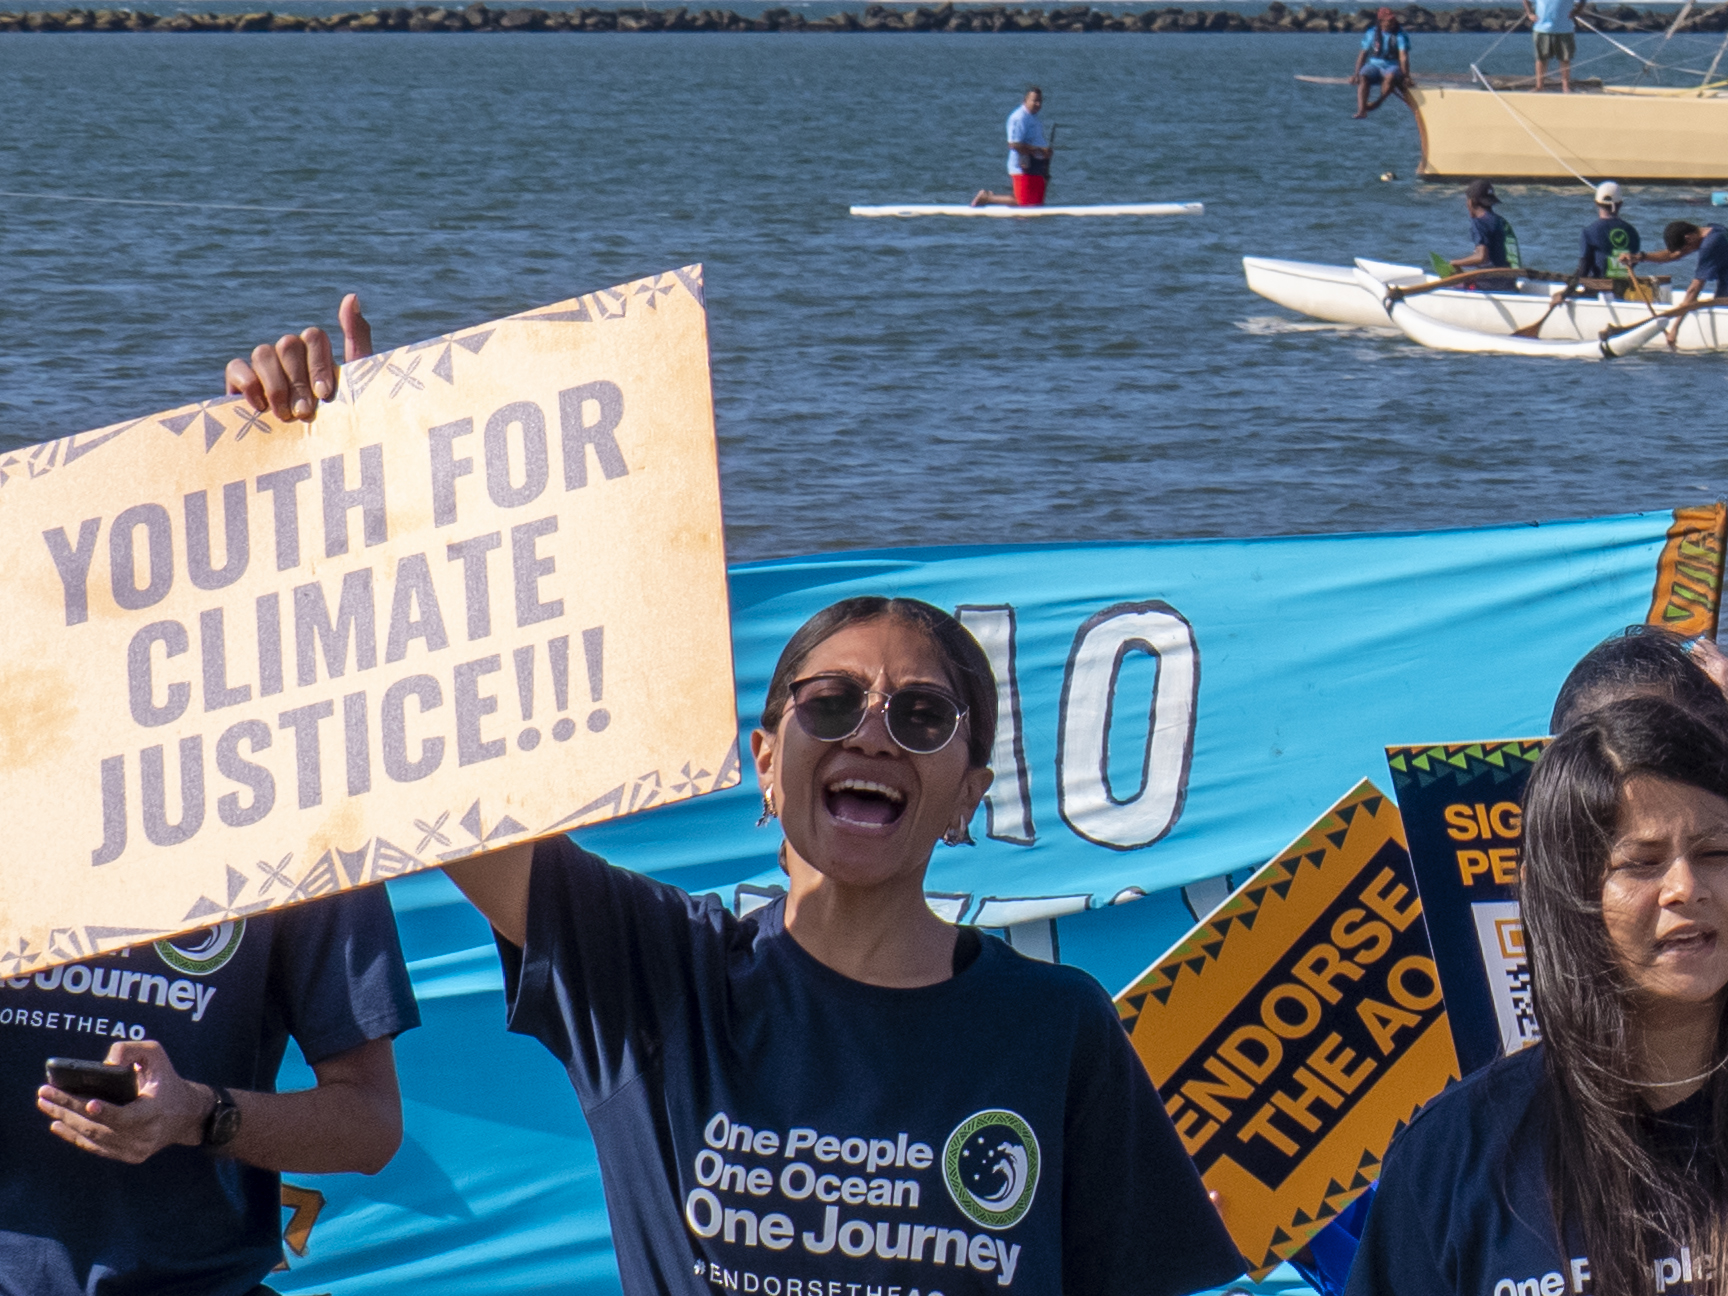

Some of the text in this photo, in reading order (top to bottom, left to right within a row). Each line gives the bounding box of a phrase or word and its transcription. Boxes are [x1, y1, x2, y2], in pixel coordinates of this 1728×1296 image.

[42, 379, 629, 627] YOUTH FOR
[126, 515, 565, 729] CLIMATE
[91, 626, 612, 868] JUSTICE!!!
[35, 964, 217, 1022] Journey
[1166, 865, 1424, 1157] ENDORSE
[1236, 955, 1443, 1158] THE AO
[685, 1187, 1022, 1287] One Journey
[694, 1148, 921, 1209] One Ocean
[703, 1111, 935, 1174] One People
